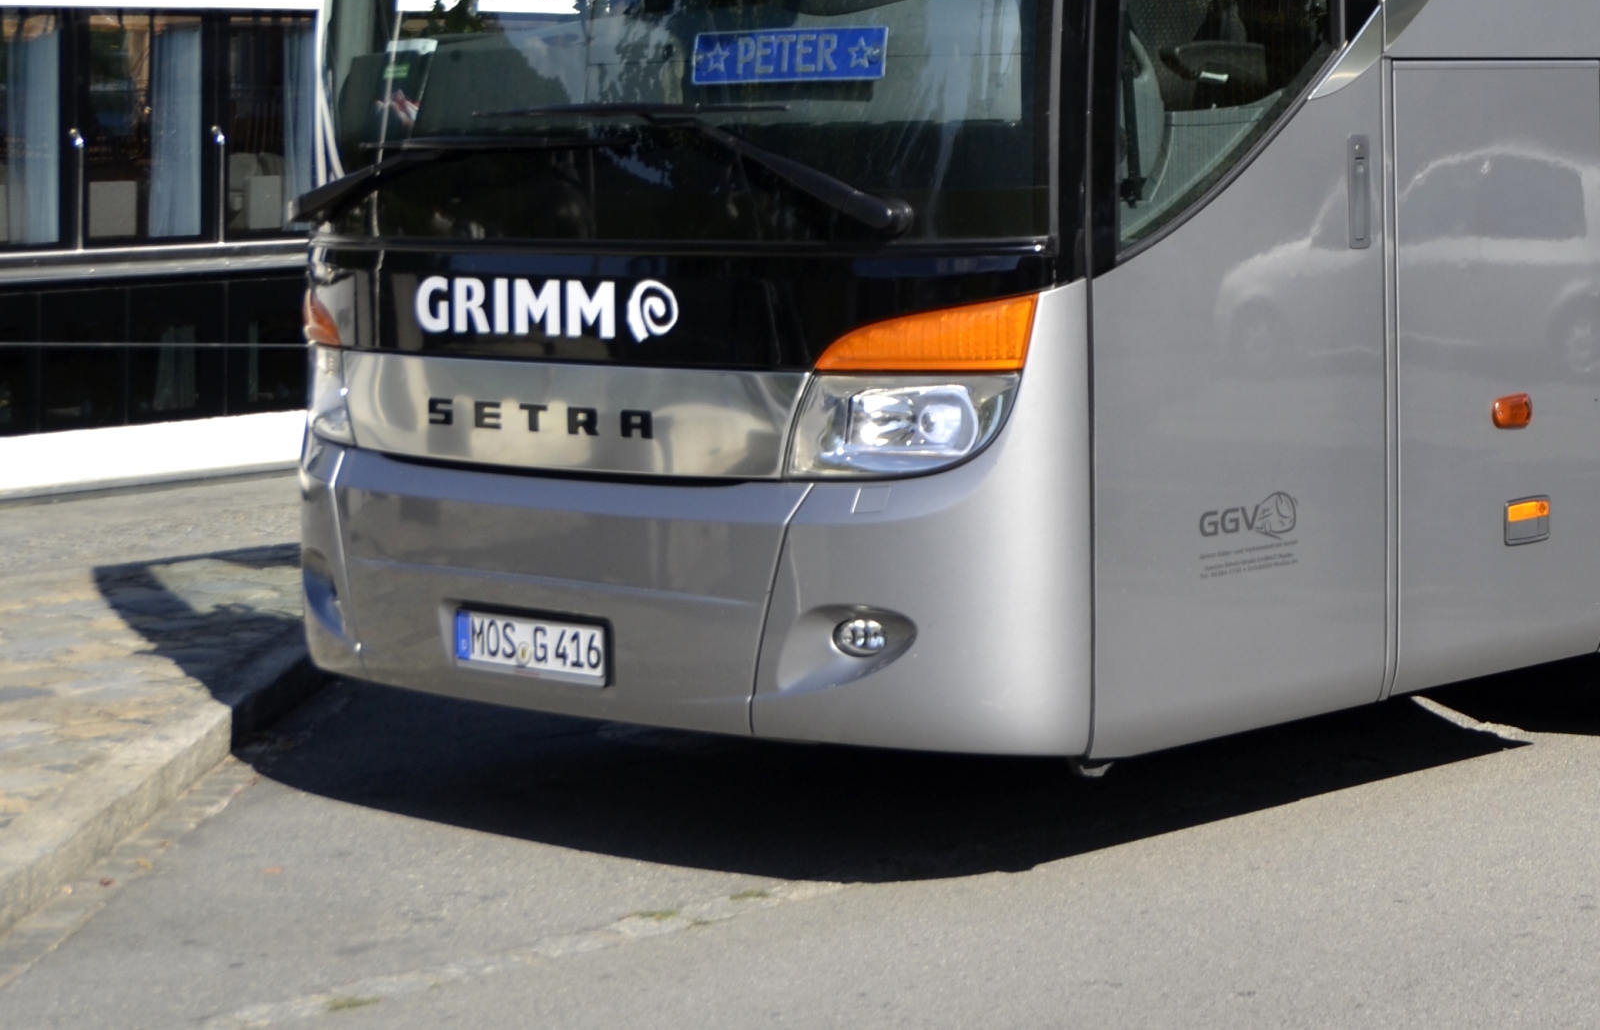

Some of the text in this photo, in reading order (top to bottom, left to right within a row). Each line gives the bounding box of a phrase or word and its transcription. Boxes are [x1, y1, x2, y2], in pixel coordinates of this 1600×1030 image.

[736, 33, 839, 75] PETER
[415, 275, 616, 339] GRIMM
[428, 397, 654, 440] SETRA
[1199, 504, 1261, 537] GGV
[471, 616, 516, 659] MOS
[534, 626, 548, 664] G
[556, 629, 602, 669] 416
